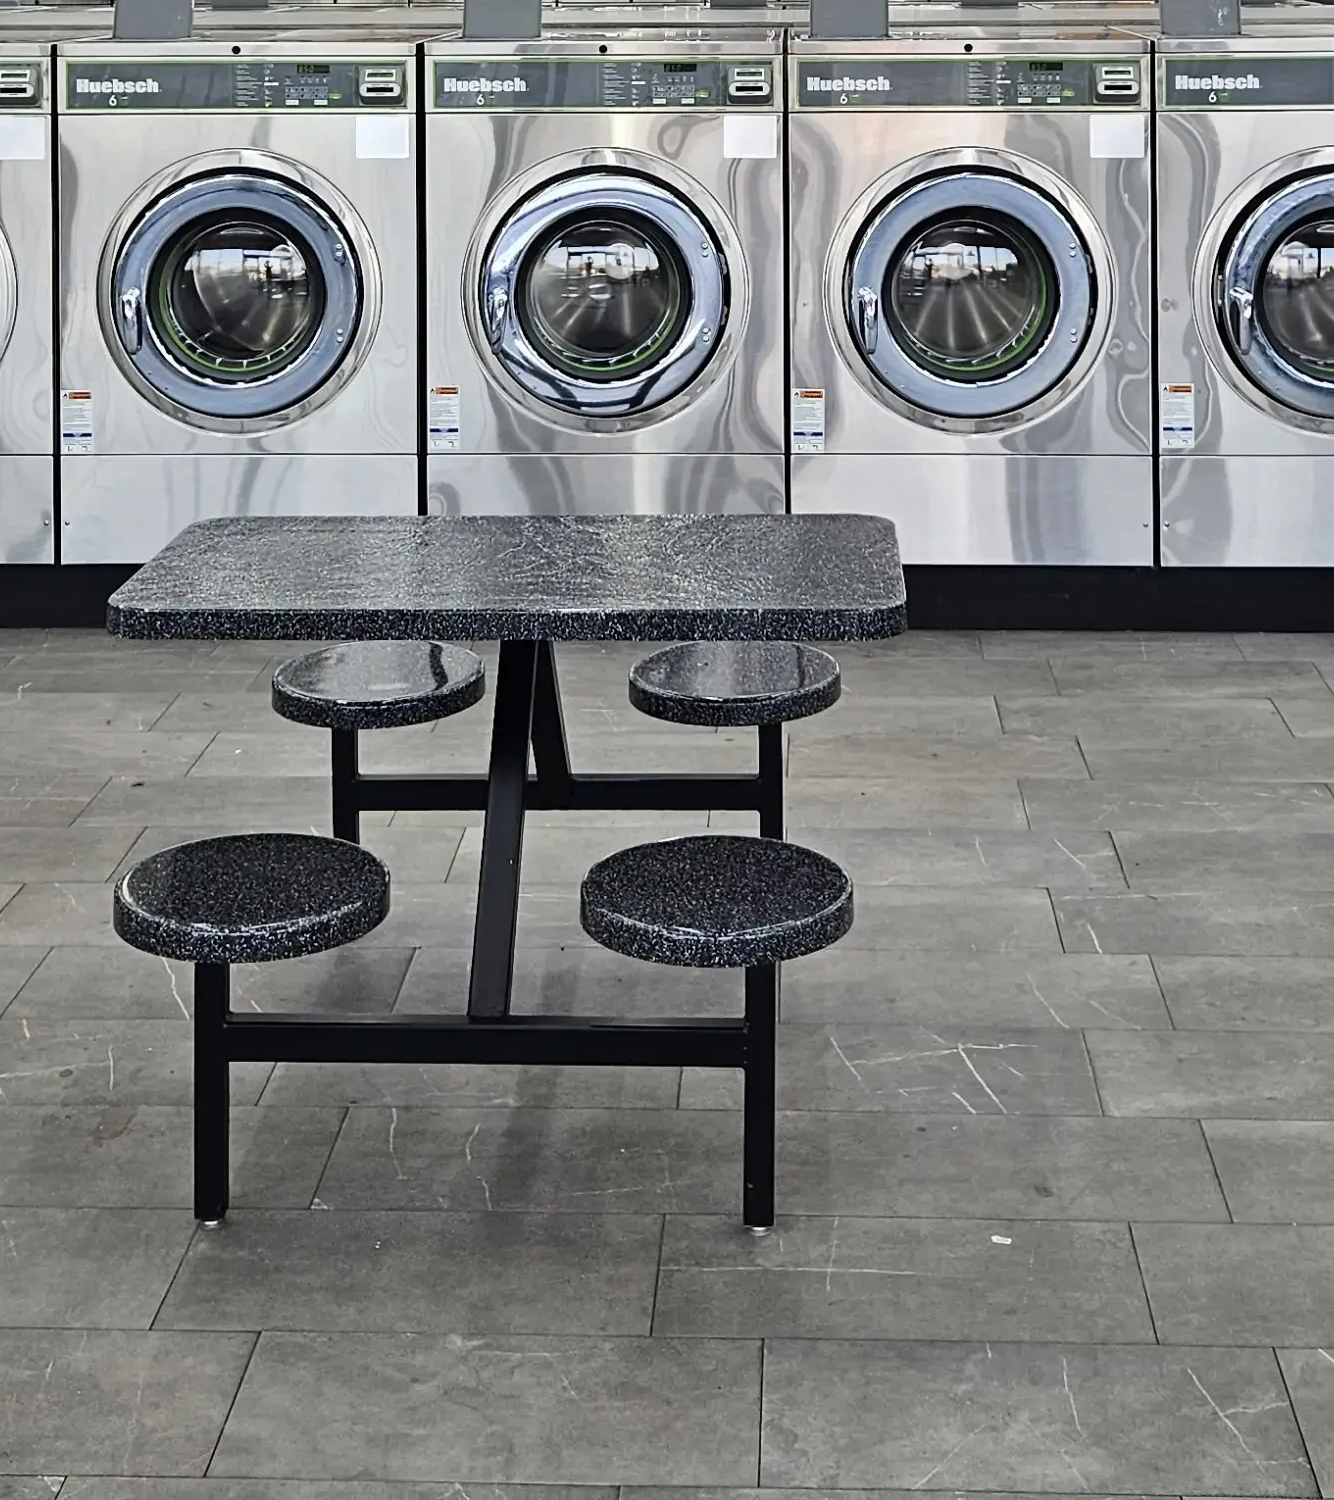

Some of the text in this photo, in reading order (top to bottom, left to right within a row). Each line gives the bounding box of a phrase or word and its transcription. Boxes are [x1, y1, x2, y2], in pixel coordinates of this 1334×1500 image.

[76, 78, 160, 93] Huebsch
[443, 77, 528, 92] Huebsch
[806, 76, 891, 91] Huebsch
[1175, 74, 1261, 90] Huebsch
[108, 95, 117, 107] 6
[476, 94, 485, 106] 6
[839, 93, 848, 105] 6
[1208, 91, 1217, 103] 6
